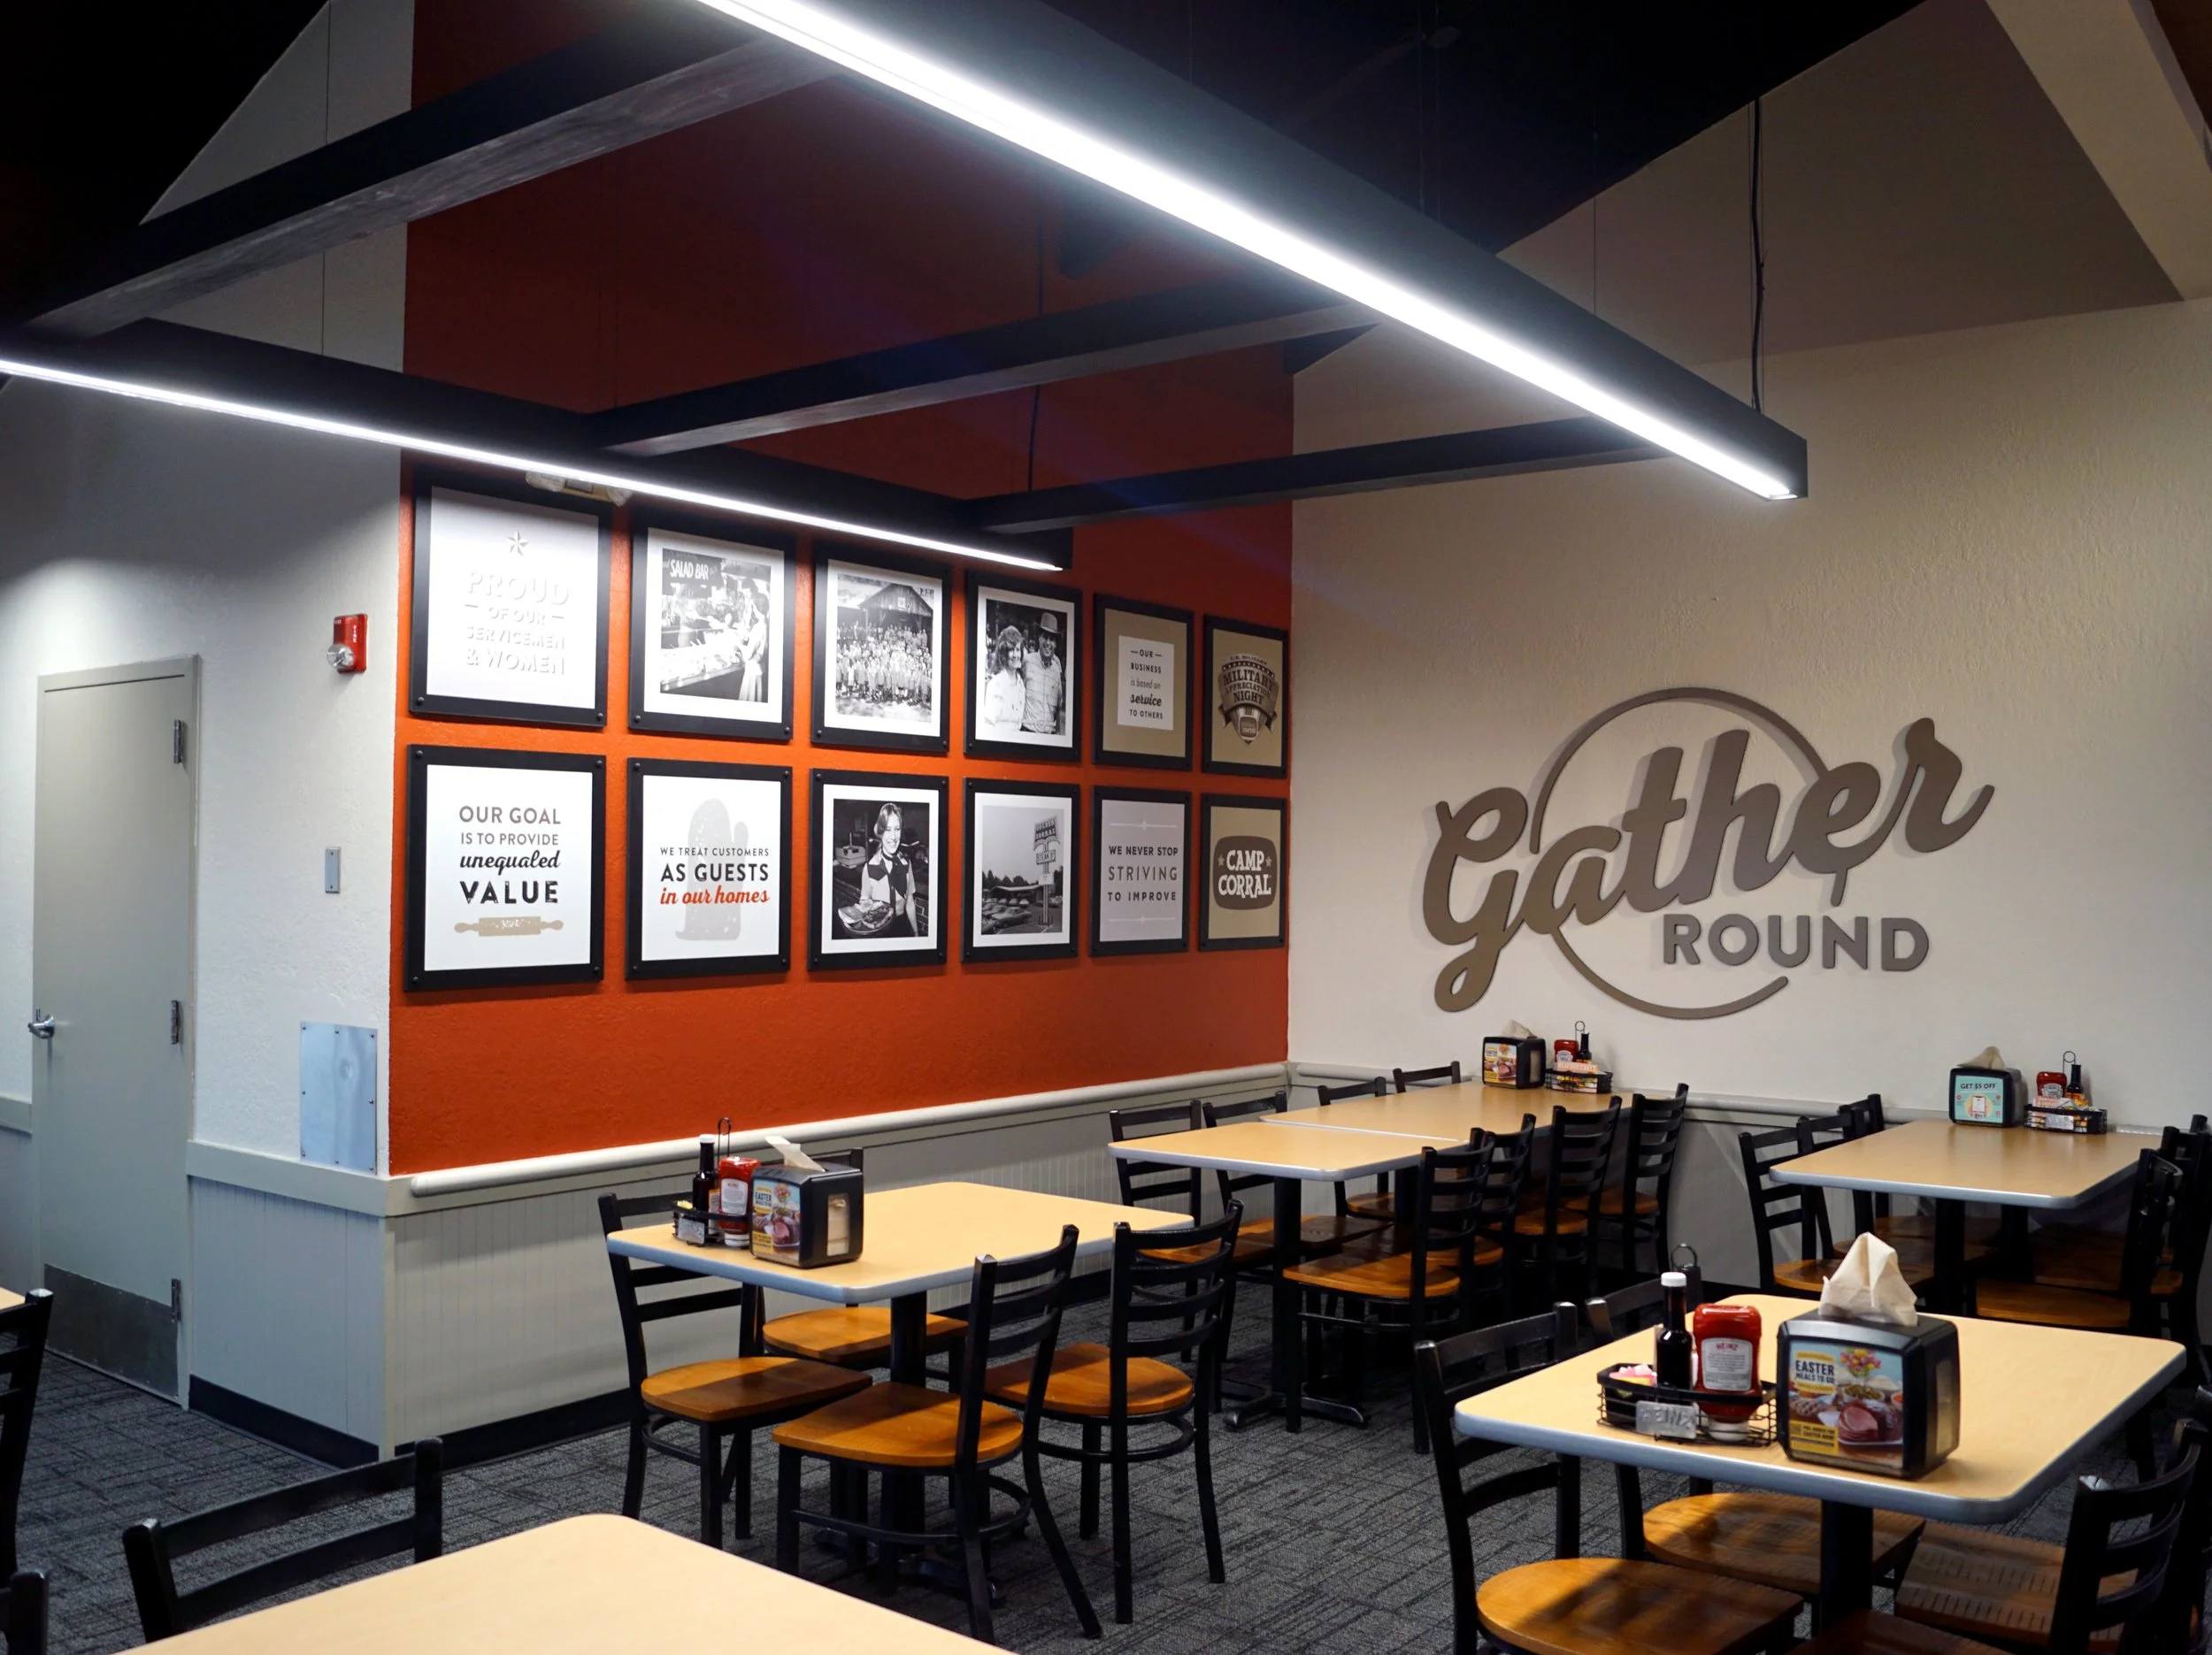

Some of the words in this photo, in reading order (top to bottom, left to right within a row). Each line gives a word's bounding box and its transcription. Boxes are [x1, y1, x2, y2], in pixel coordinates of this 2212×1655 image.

[670, 559, 694, 578] SALAD
[695, 563, 710, 580] BAR
[466, 571, 569, 606] PROUD
[488, 607, 509, 620] OF
[513, 610, 546, 625] OUR
[466, 625, 565, 650] SERVICEMEN
[466, 647, 480, 666] &
[484, 648, 565, 675] WOMEN
[1139, 649, 1154, 658] OUR
[1130, 663, 1162, 674] BUSINESS
[1136, 678, 1154, 689] based
[1223, 670, 1274, 690] MILITARY
[1130, 693, 1163, 707] service
[1233, 690, 1263, 705] NIGHT
[1140, 710, 1164, 720] OTHERS
[459, 806, 503, 824] OUR
[509, 808, 561, 824] GOAL
[461, 832, 473, 845] IS
[477, 832, 495, 846] TO
[499, 833, 559, 846] PROVIDE
[660, 847, 674, 856] WE
[679, 847, 709, 856] TREAT
[711, 847, 770, 856] CUSTOMERS
[1109, 846, 1122, 855] WE
[1125, 846, 1154, 856] NEVER
[1157, 847, 1179, 856] STOP
[1226, 849, 1265, 871] CAMP
[459, 849, 561, 876] unequaled
[1422, 717, 1995, 1013] Gather
[660, 863, 686, 882] AS
[695, 863, 769, 882] GUESTS
[1109, 866, 1178, 881] STRIVING
[459, 880, 559, 904] VALUE
[660, 886, 679, 905] in
[682, 889, 712, 905] our
[714, 885, 771, 904] homes
[1217, 874, 1272, 899] CORRAL
[1108, 892, 1121, 901] TO
[1128, 892, 1176, 901] IMPROVE
[1663, 913, 1930, 972] ROUND
[1795, 1360, 1834, 1376] EASTER
